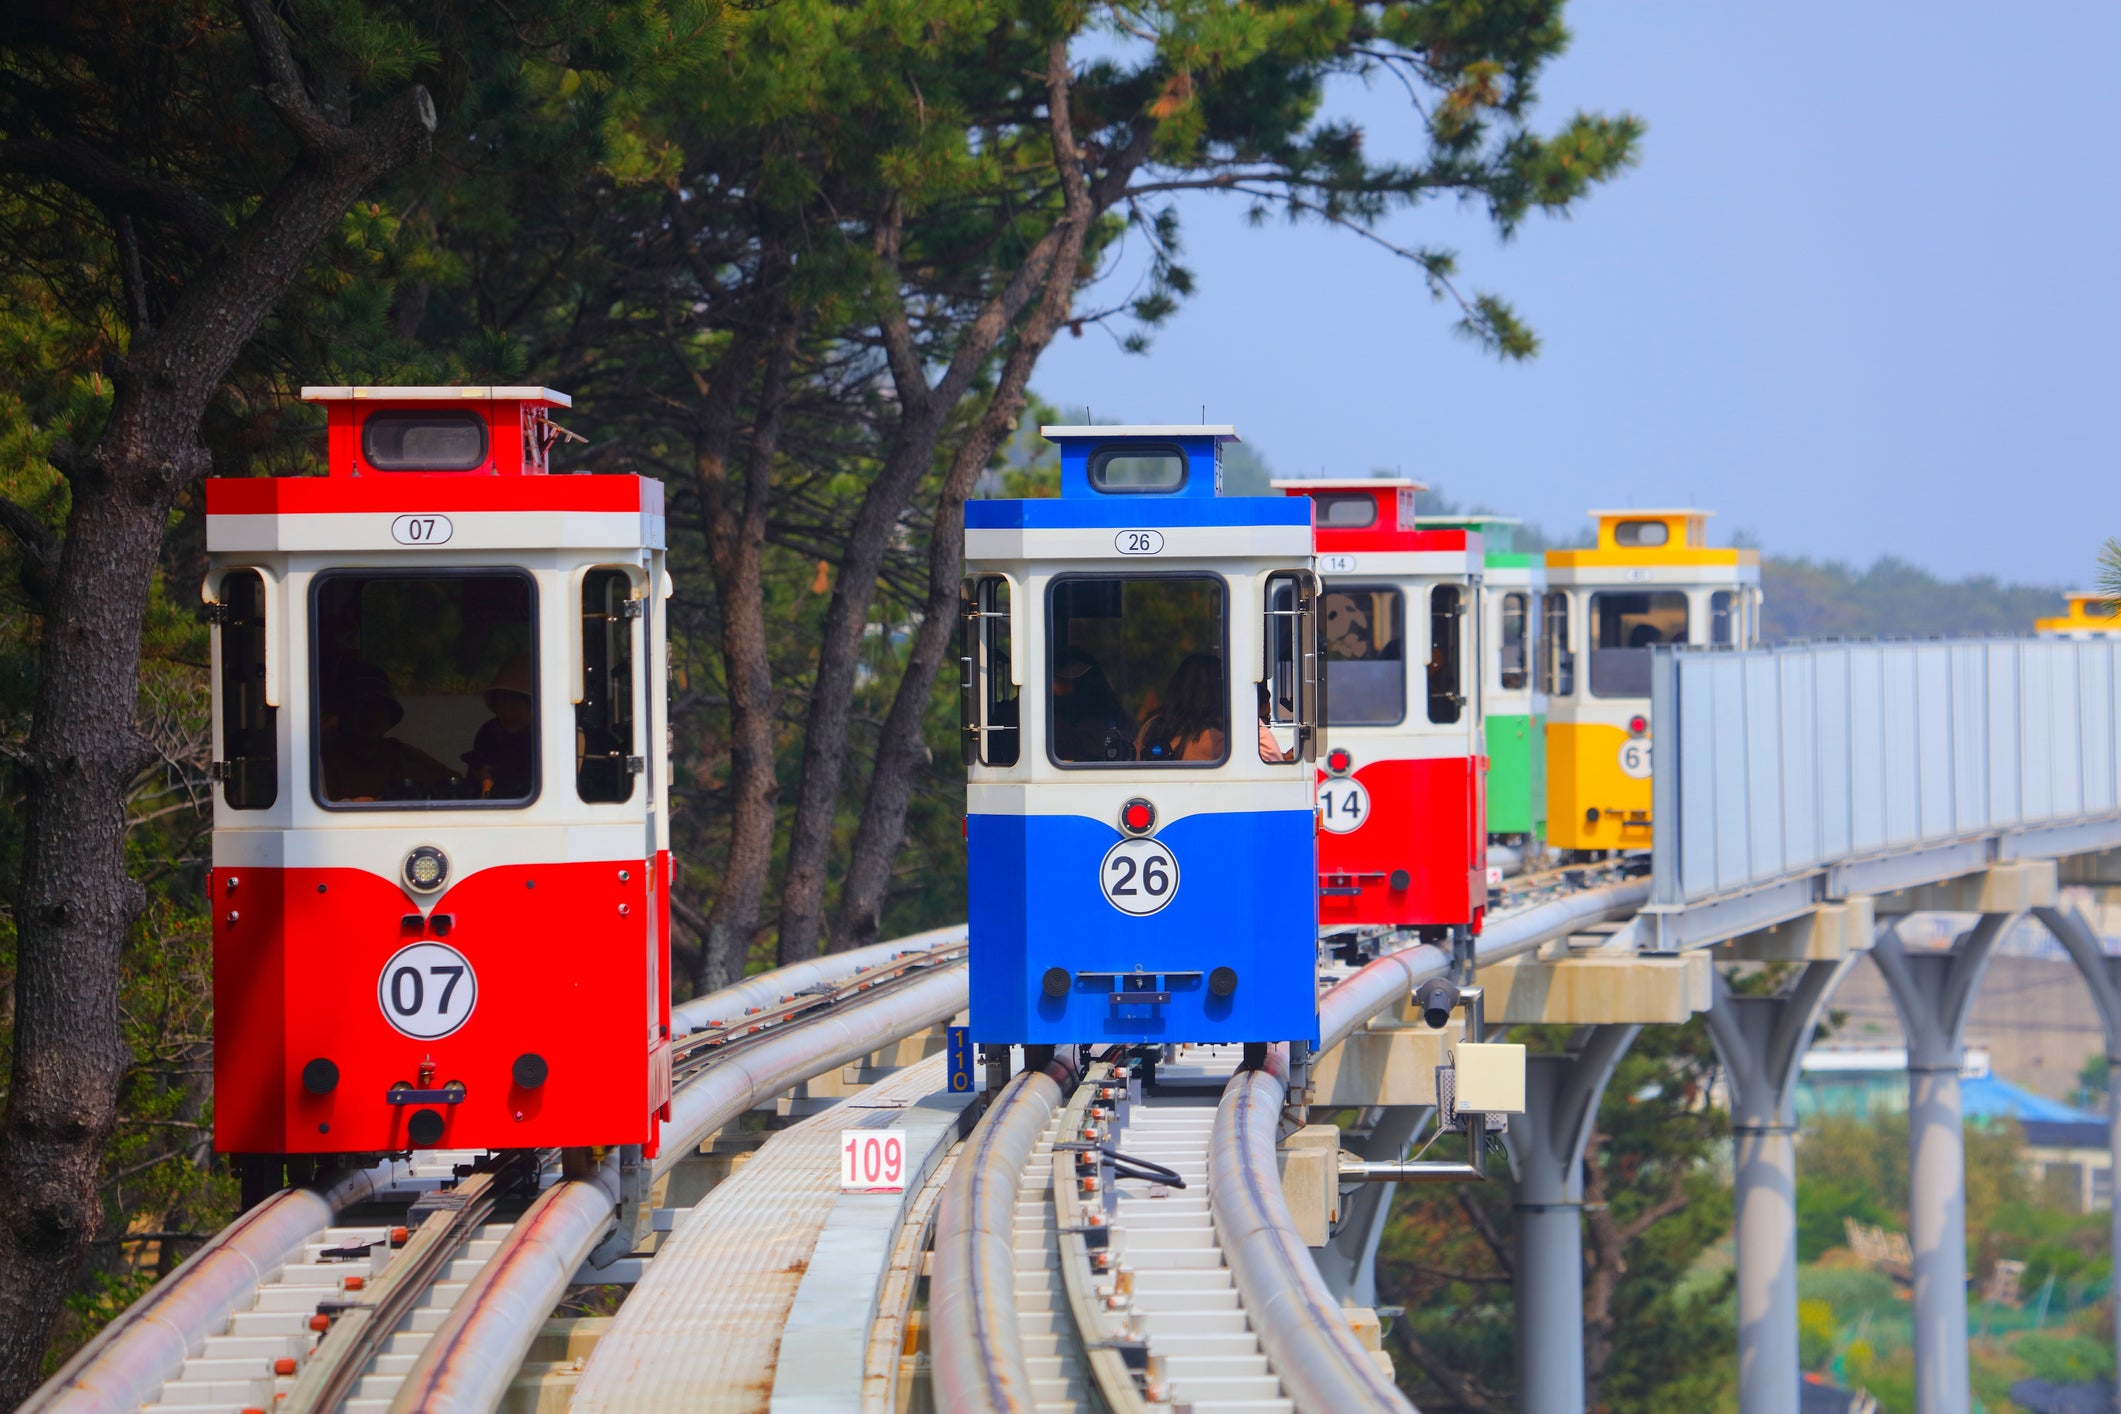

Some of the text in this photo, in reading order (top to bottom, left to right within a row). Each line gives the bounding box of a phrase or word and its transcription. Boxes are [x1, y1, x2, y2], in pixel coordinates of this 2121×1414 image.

[409, 519, 435, 540] 07
[1129, 533, 1150, 551] 26
[1331, 557, 1345, 569] 14
[1320, 790, 1361, 819] 14
[1111, 855, 1169, 896] 26
[391, 965, 464, 1016] 07
[953, 1029, 969, 1091] 110
[845, 1137, 902, 1183] 109
